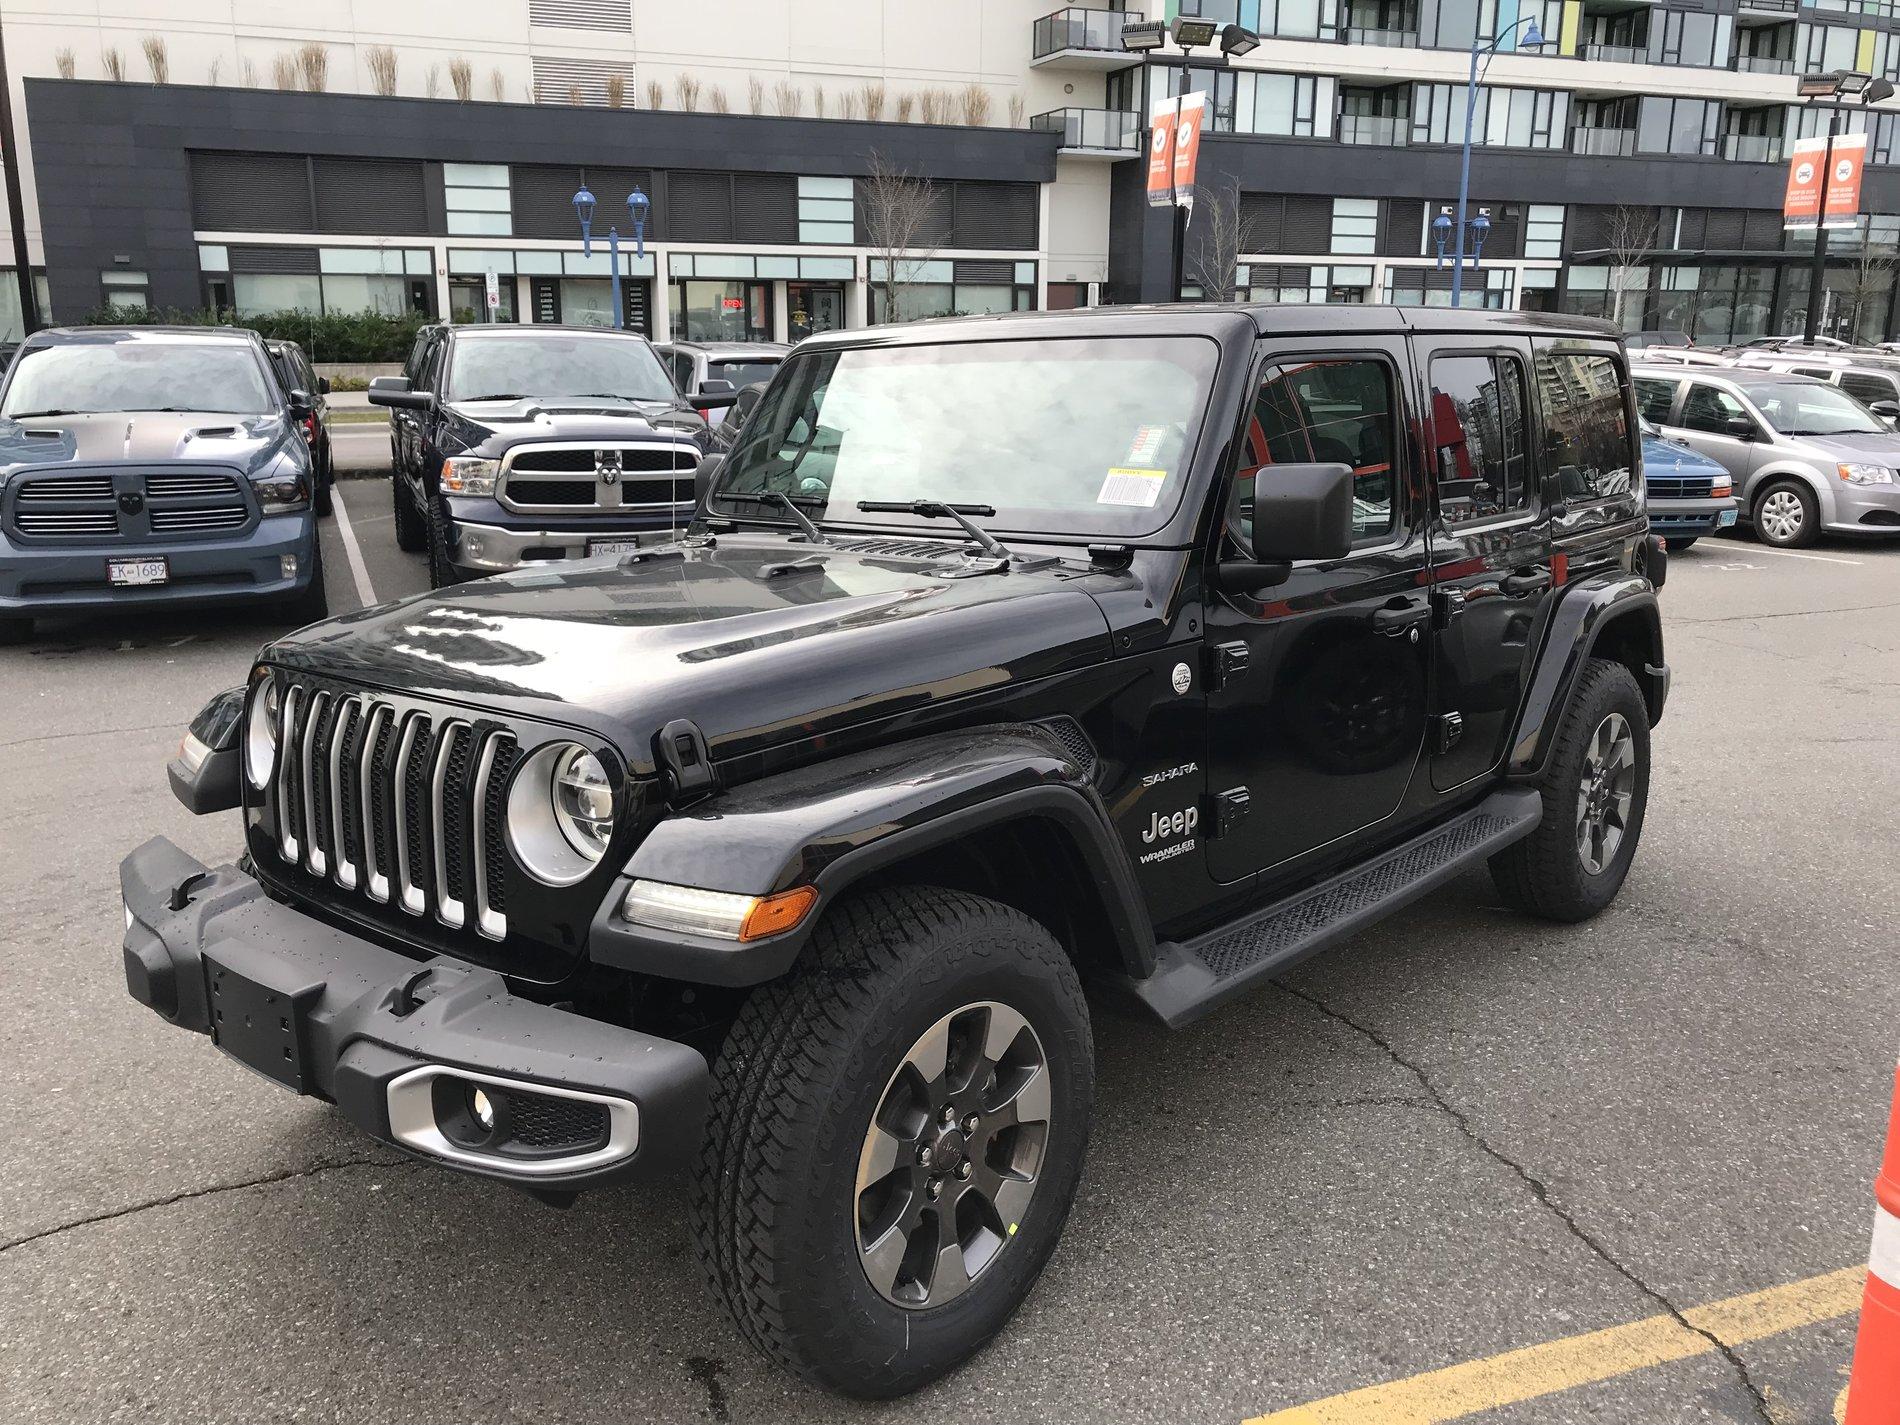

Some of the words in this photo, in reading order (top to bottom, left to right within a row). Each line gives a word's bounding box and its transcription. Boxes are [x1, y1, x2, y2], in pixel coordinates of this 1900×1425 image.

[723, 298, 744, 309] OPEN
[1142, 762, 1199, 787] SAHARA
[1142, 806, 1198, 844] Jeep
[1140, 839, 1195, 864] WRANGLER
